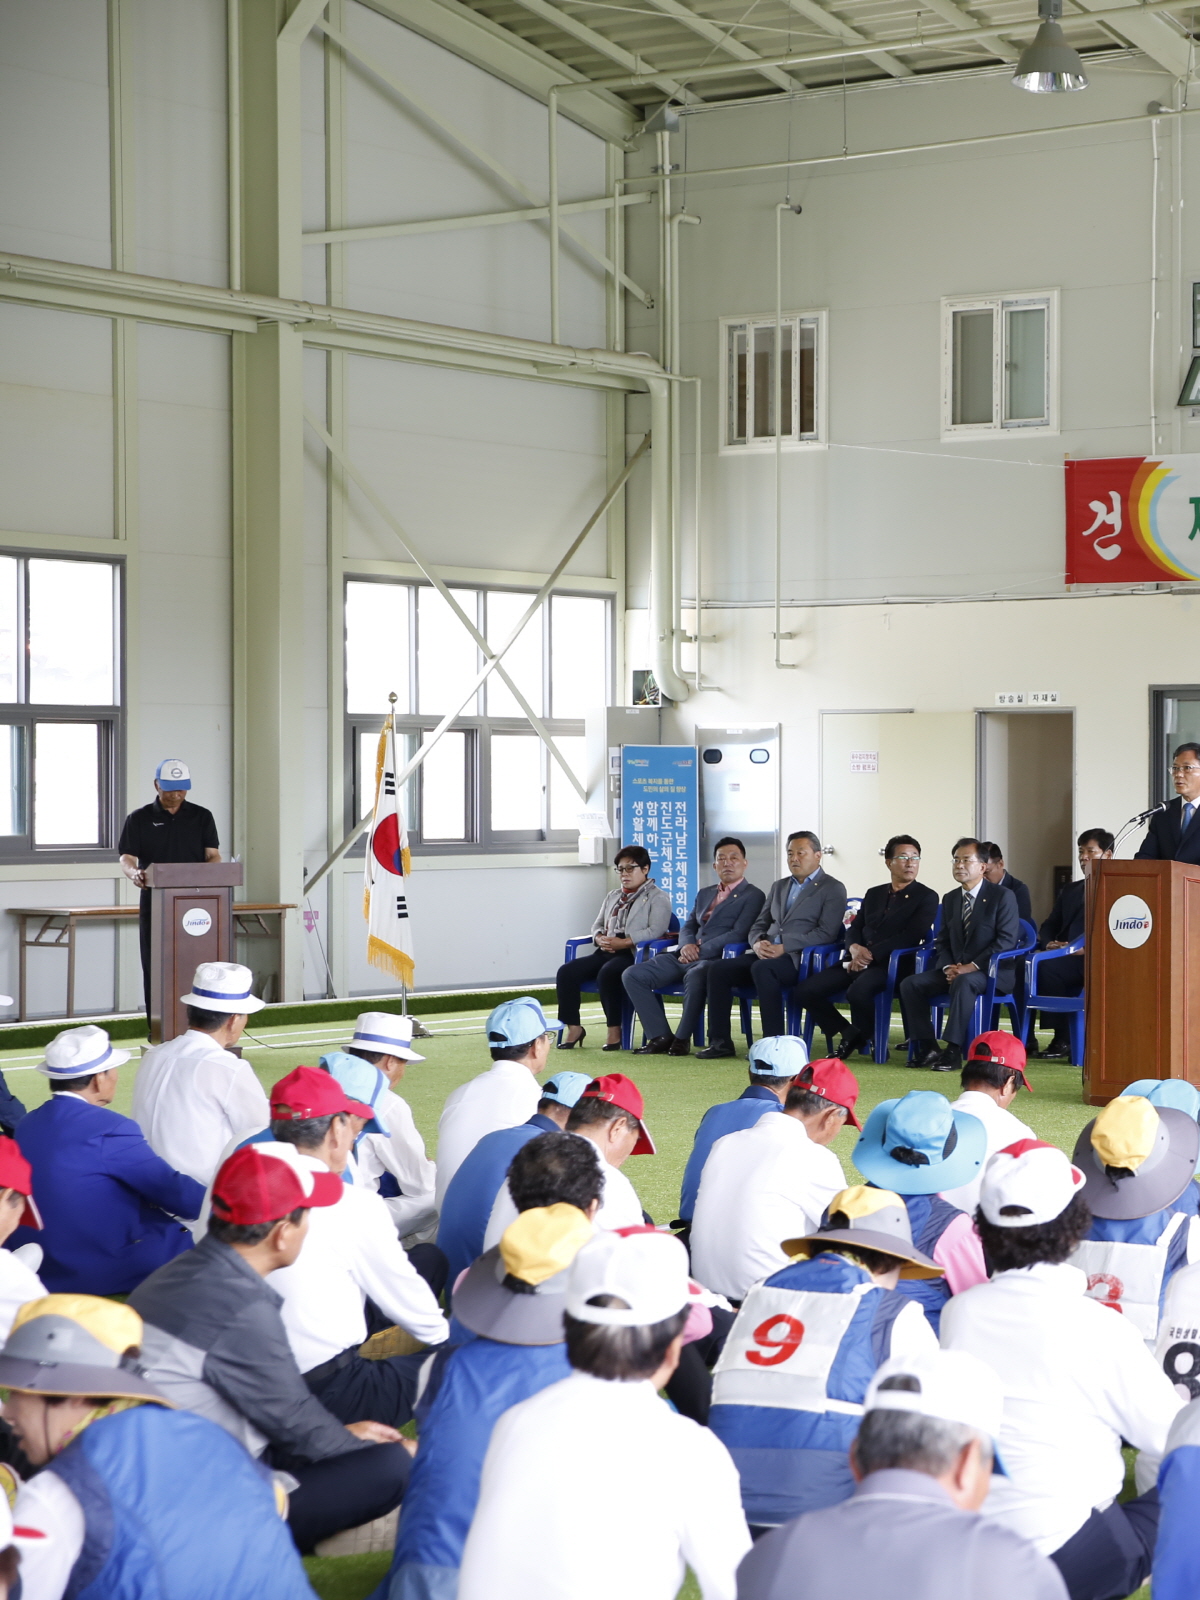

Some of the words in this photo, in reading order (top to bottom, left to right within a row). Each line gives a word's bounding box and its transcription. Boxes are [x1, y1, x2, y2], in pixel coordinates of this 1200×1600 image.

[660, 801, 674, 904] 진도군체육회
[674, 801, 689, 921] 전라남도체육회와
[1112, 919, 1143, 931] Jindo
[745, 1313, 805, 1368] 9
